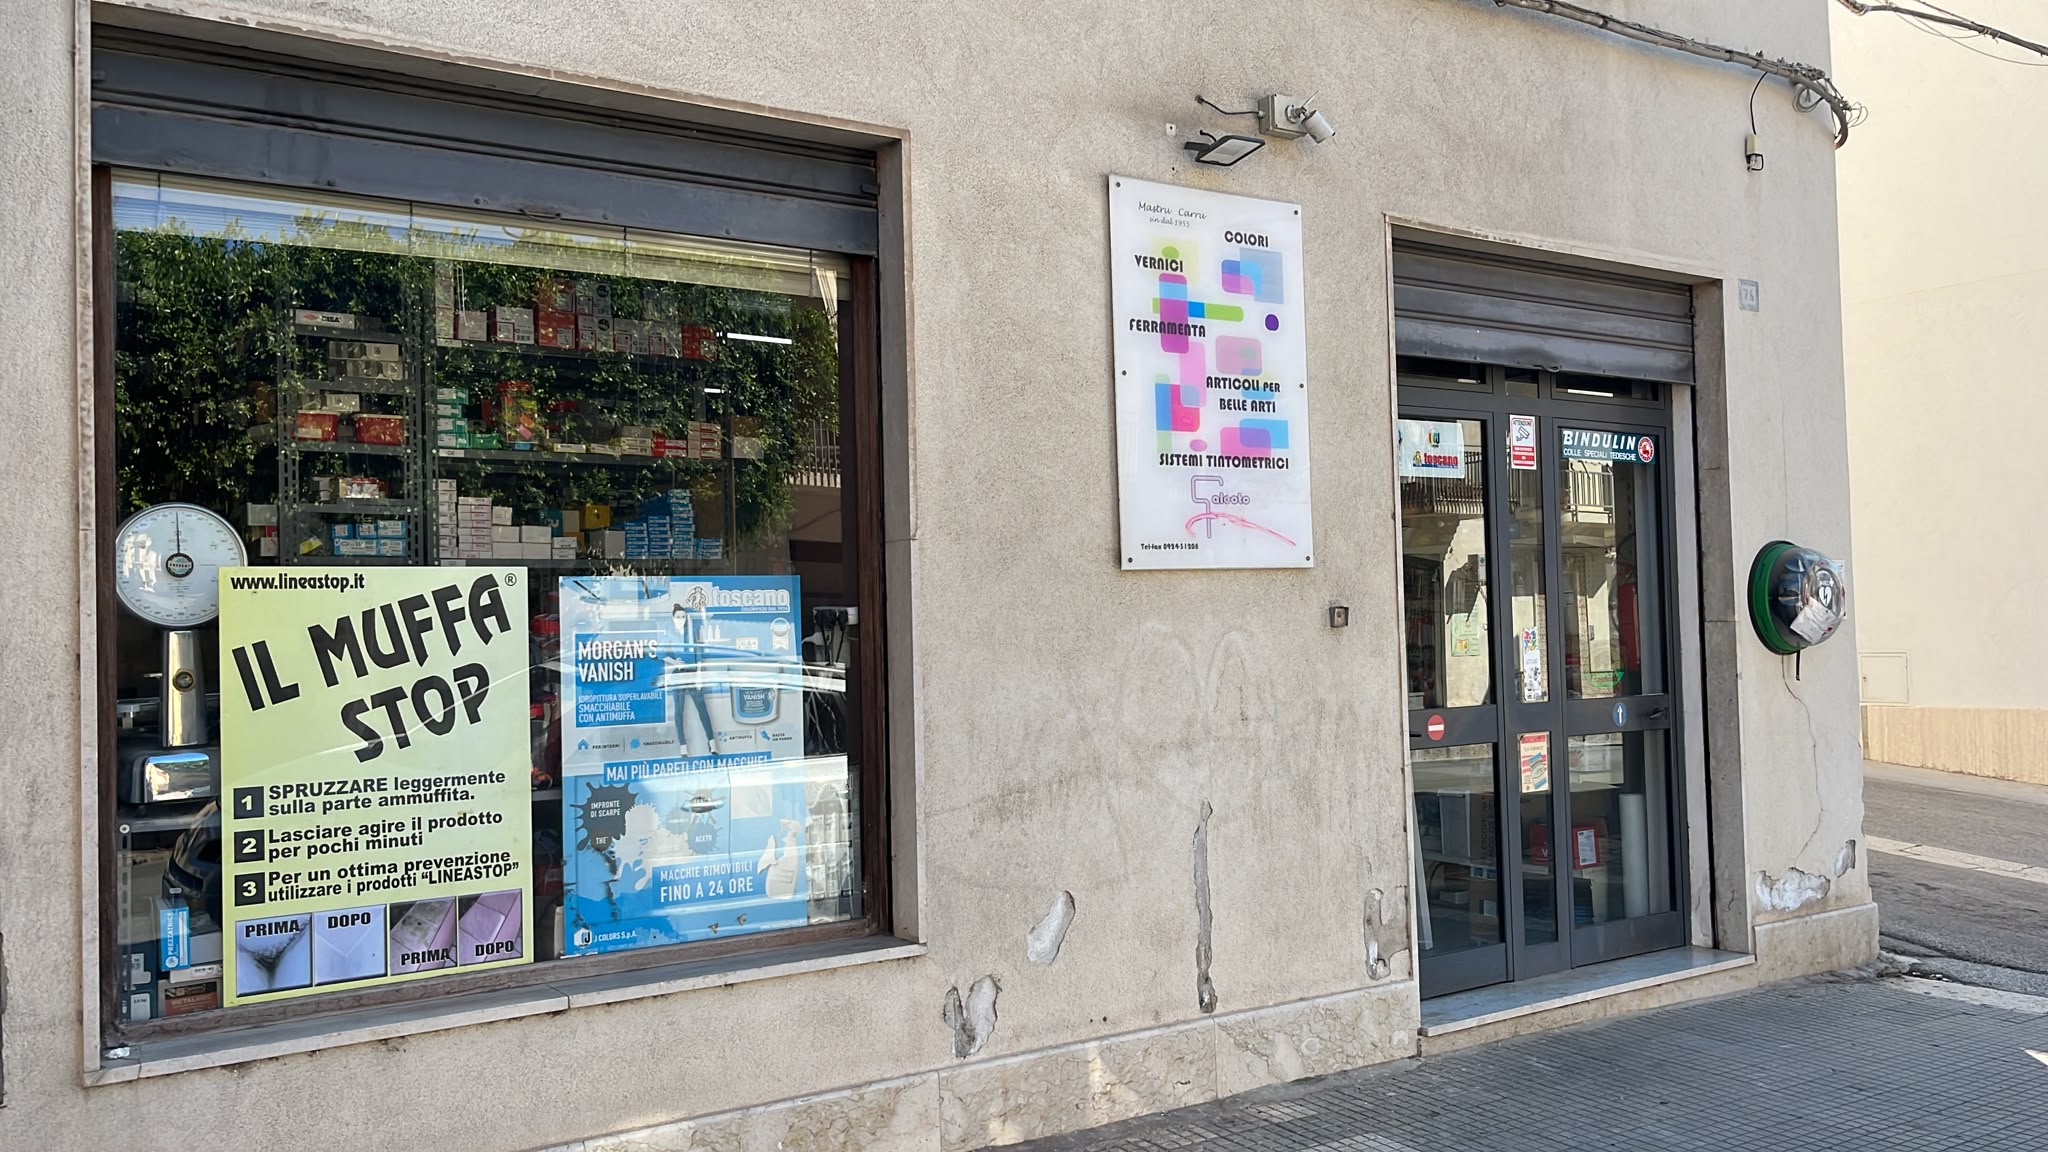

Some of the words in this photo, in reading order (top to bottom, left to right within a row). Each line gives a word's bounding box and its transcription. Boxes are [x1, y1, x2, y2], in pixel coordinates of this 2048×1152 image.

[1138, 201, 1172, 215] Mastru
[1178, 207, 1207, 220] Carru
[1224, 230, 1269, 248] COLORI
[1134, 254, 1184, 273] VERNICI
[1129, 318, 1206, 338] FERRAMENTA
[1206, 376, 1260, 392] ARTICOLI
[1263, 382, 1281, 393] PER
[1219, 398, 1247, 411] BELLE
[1251, 400, 1276, 413] ARTI
[1563, 430, 1636, 451] BINDULIN
[1159, 453, 1203, 467] SISTEMI
[1206, 455, 1289, 469] TINTOMETRICI
[1424, 452, 1458, 466] toscano
[1563, 448, 1581, 457] COLLE
[1584, 449, 1607, 459] SPECIALI
[1610, 451, 1637, 461] TEDESCHE
[230, 573, 365, 593] www.lineastop.it
[712, 586, 788, 606] toscano
[231, 640, 300, 711] IL
[307, 573, 512, 688] MUFFA
[578, 639, 658, 661] MORGAN'S
[578, 661, 635, 683] VANISH
[578, 693, 617, 704] IDROPITTURA
[617, 691, 664, 701] SUPERLAVABILE
[578, 701, 632, 713] SMACCHIABILE
[340, 662, 490, 763] STOP
[578, 713, 595, 723] CON
[595, 711, 636, 722] ANTIMUFFA
[606, 765, 628, 782] MAI
[630, 760, 650, 780] PIÙ
[653, 761, 690, 777] PARETI
[692, 758, 715, 772] CON
[269, 777, 388, 800] SPRUZZARE
[394, 770, 506, 793] leggermente
[241, 795, 254, 812] 1
[269, 799, 316, 816] sulla
[322, 795, 373, 815] parte
[378, 787, 475, 807] ammuffita.
[590, 800, 621, 810] IMPRONTE
[599, 808, 621, 818] SCARPE
[269, 825, 353, 844] Lasciare
[358, 819, 406, 839] agire
[411, 816, 422, 831] il
[428, 811, 503, 833] prodotto
[242, 837, 257, 854] 2
[269, 845, 302, 863] per
[307, 837, 360, 859] pochi
[366, 832, 424, 851] minuti
[269, 870, 302, 886] Per
[308, 869, 331, 882] un
[337, 861, 398, 879] ottima
[404, 850, 511, 876] prevenzione
[660, 866, 700, 882] MACCHIE
[703, 861, 753, 877] RIMOVIBILI
[242, 880, 257, 897] 3
[268, 883, 343, 902] utilizzare
[347, 879, 352, 894] i
[356, 872, 417, 896] prodotti
[660, 884, 690, 903] FINO
[695, 882, 704, 898] A
[708, 880, 724, 896] 24
[728, 876, 754, 894] ORE
[245, 919, 301, 938] PRIMA
[327, 912, 372, 929] DOPO
[598, 932, 620, 941] COLORS
[400, 947, 451, 966] PRIMA
[474, 940, 515, 957] DOPO
